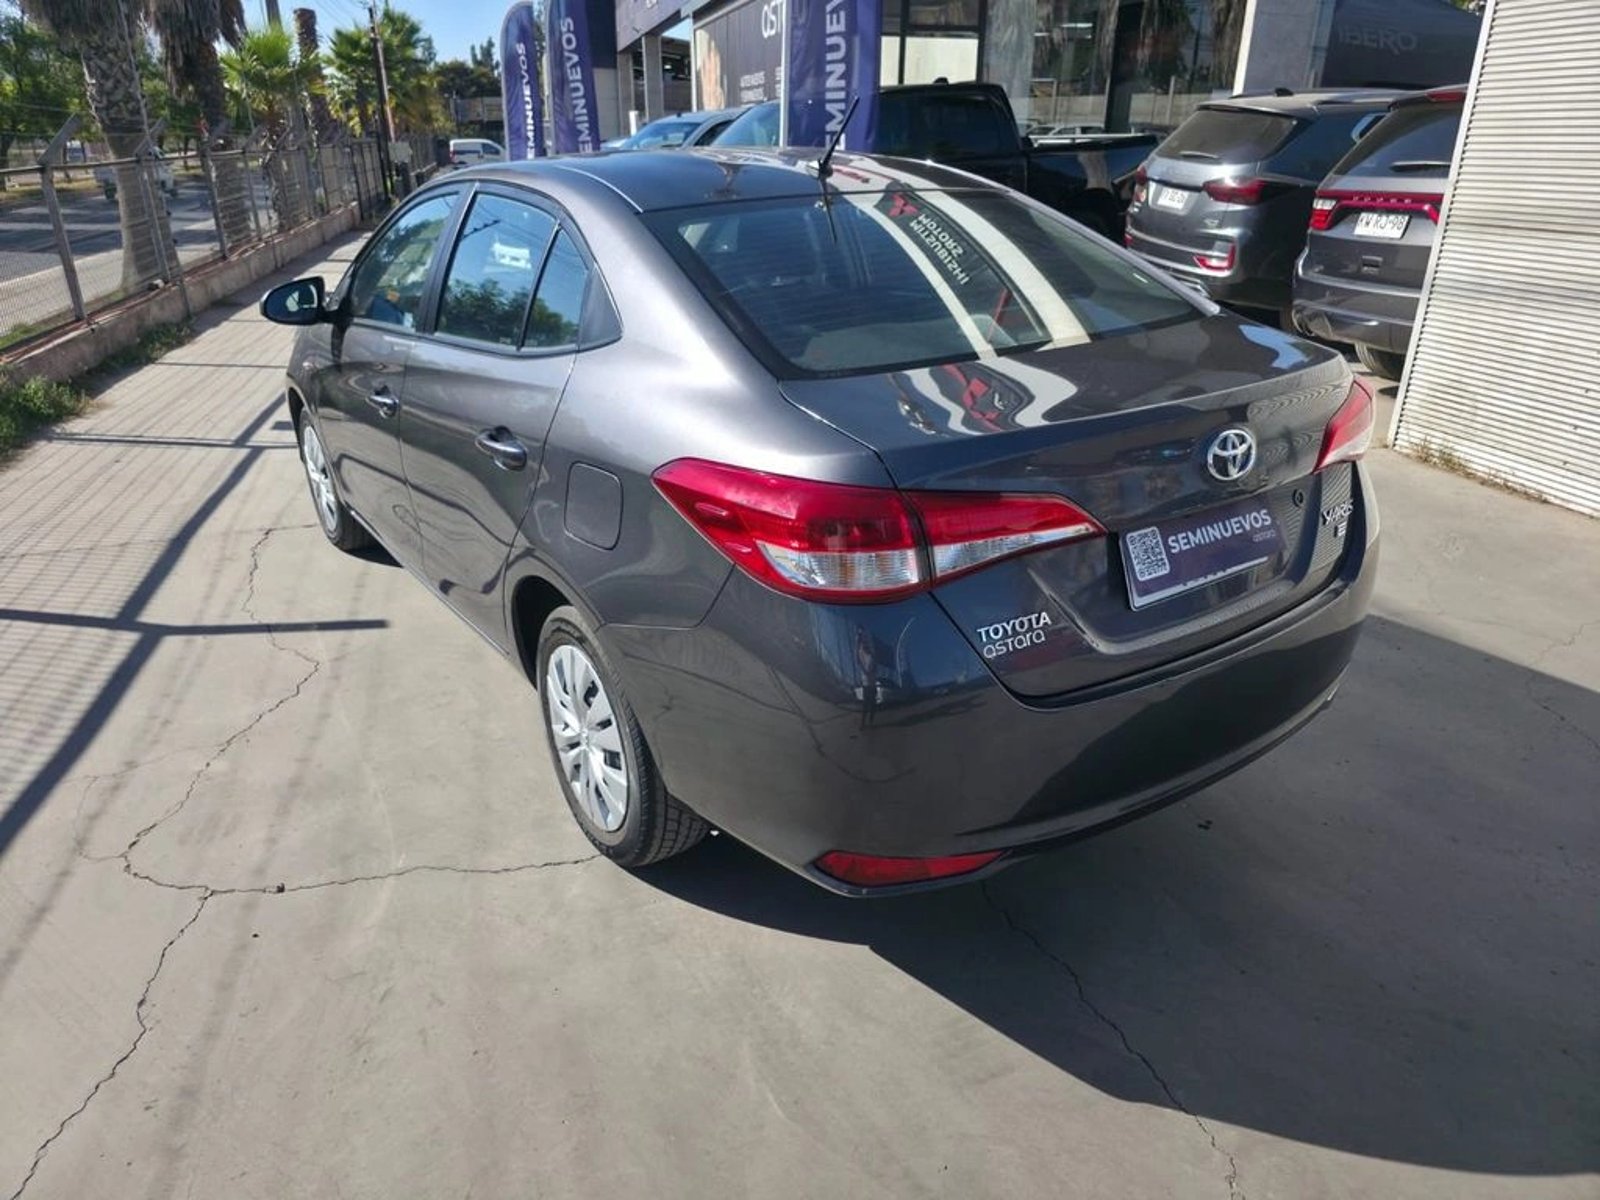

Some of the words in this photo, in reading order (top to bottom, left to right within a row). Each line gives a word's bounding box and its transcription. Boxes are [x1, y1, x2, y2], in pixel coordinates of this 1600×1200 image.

[516, 43, 535, 160] EMINUEVOS
[561, 16, 594, 153] EMINUEVOS
[1168, 509, 1272, 554] SEMINUEVOS
[976, 611, 1052, 643] TOYOTA
